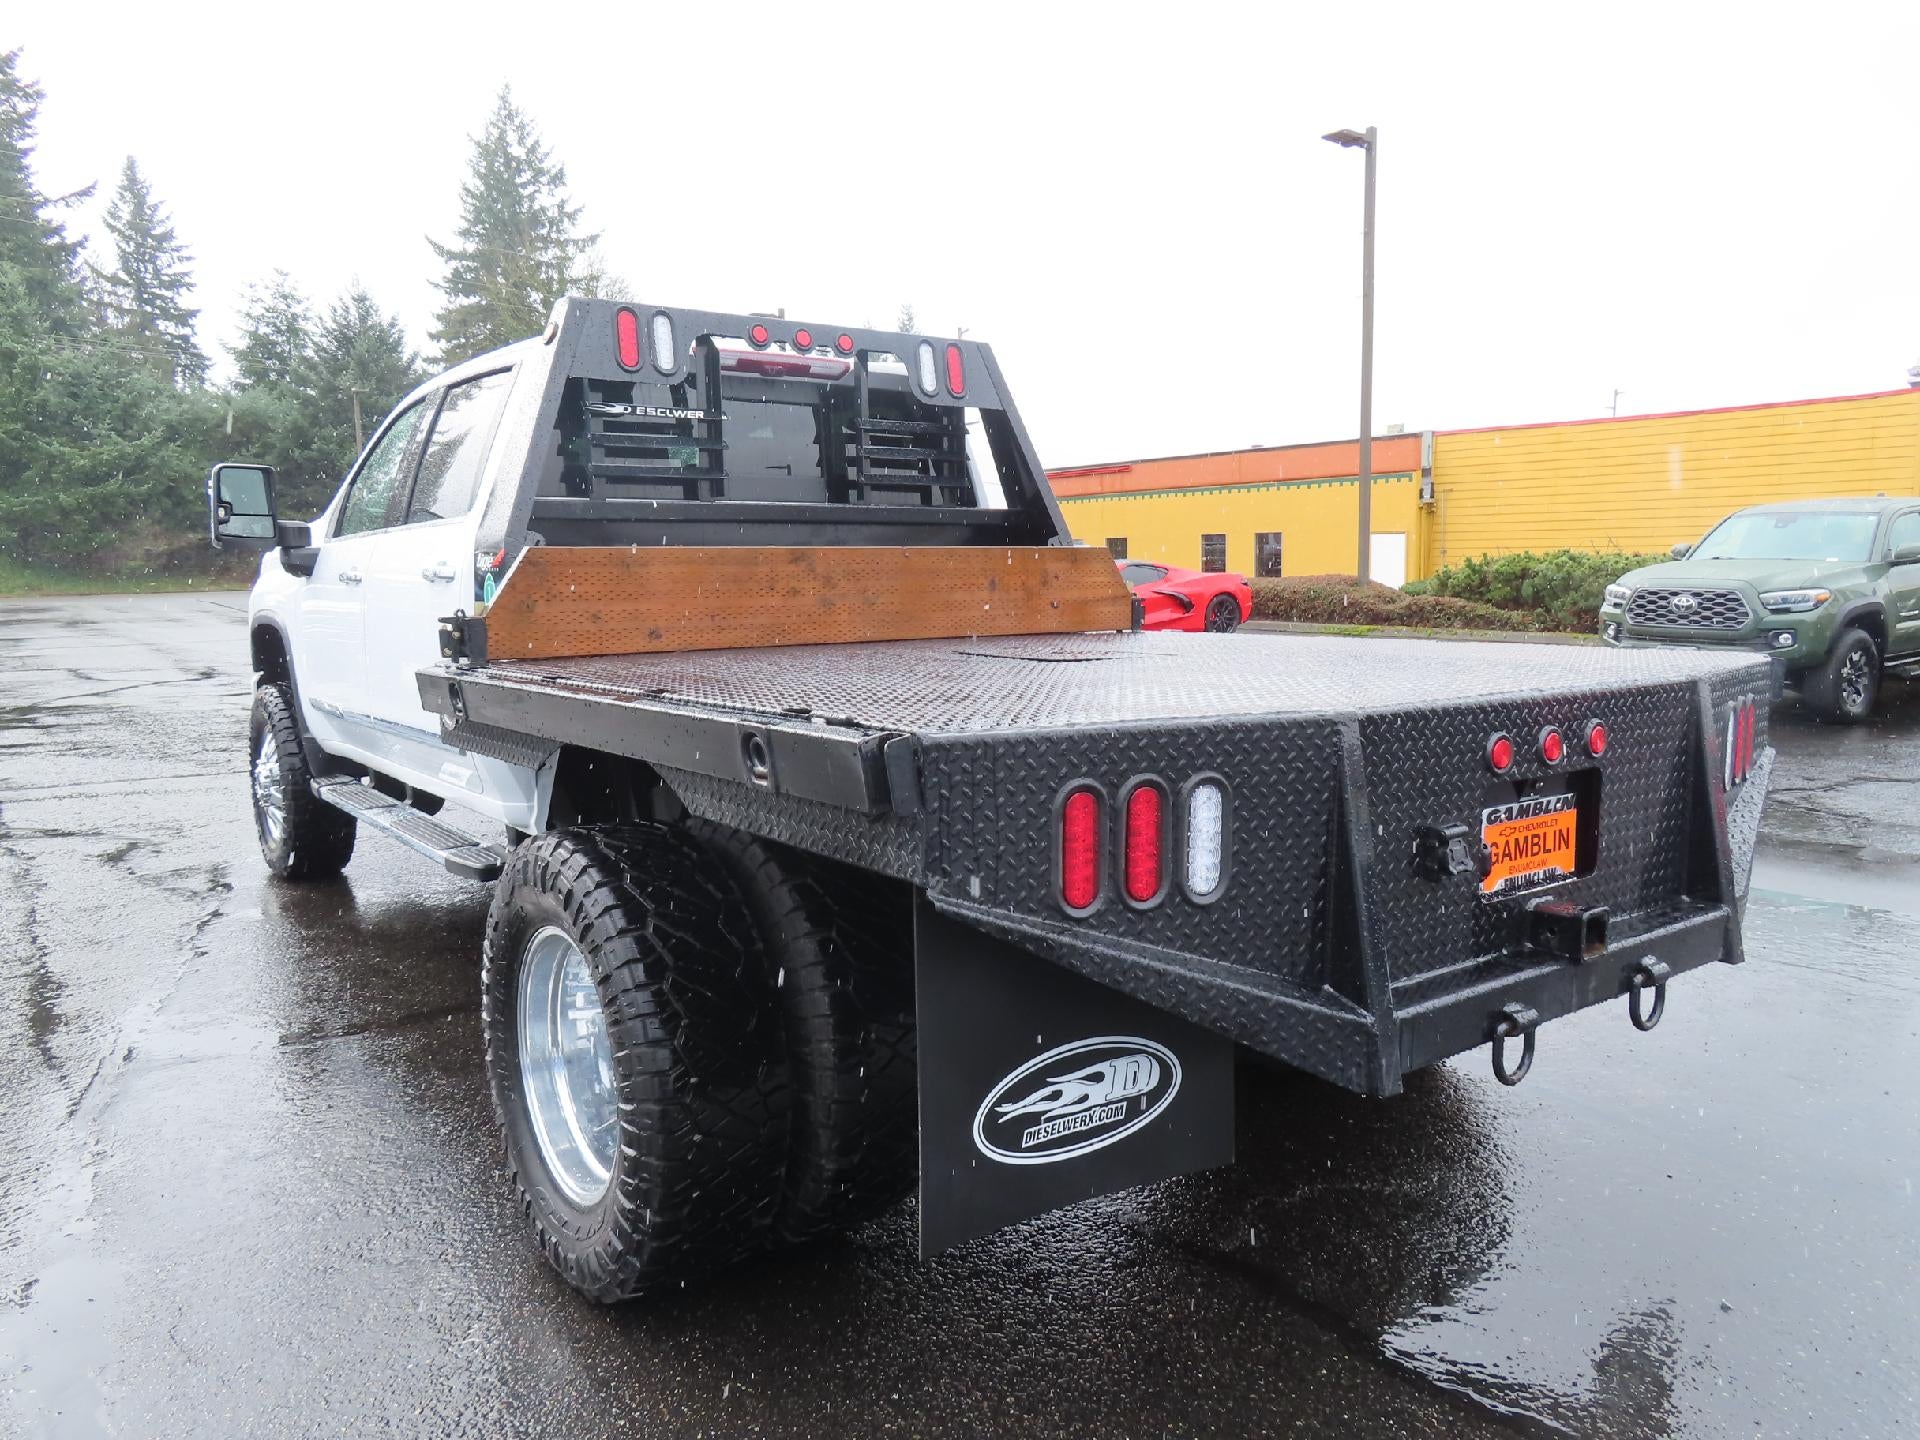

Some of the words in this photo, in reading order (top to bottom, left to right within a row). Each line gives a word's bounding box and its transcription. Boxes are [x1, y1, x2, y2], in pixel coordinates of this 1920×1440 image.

[1486, 795, 1576, 825] GAMBLIN
[1518, 819, 1558, 834] CHEVROLET
[1490, 827, 1569, 866] GAMBLIN
[1509, 859, 1547, 875] ENUMCLAW
[1024, 1104, 1124, 1145] DIESELWERX.COM
